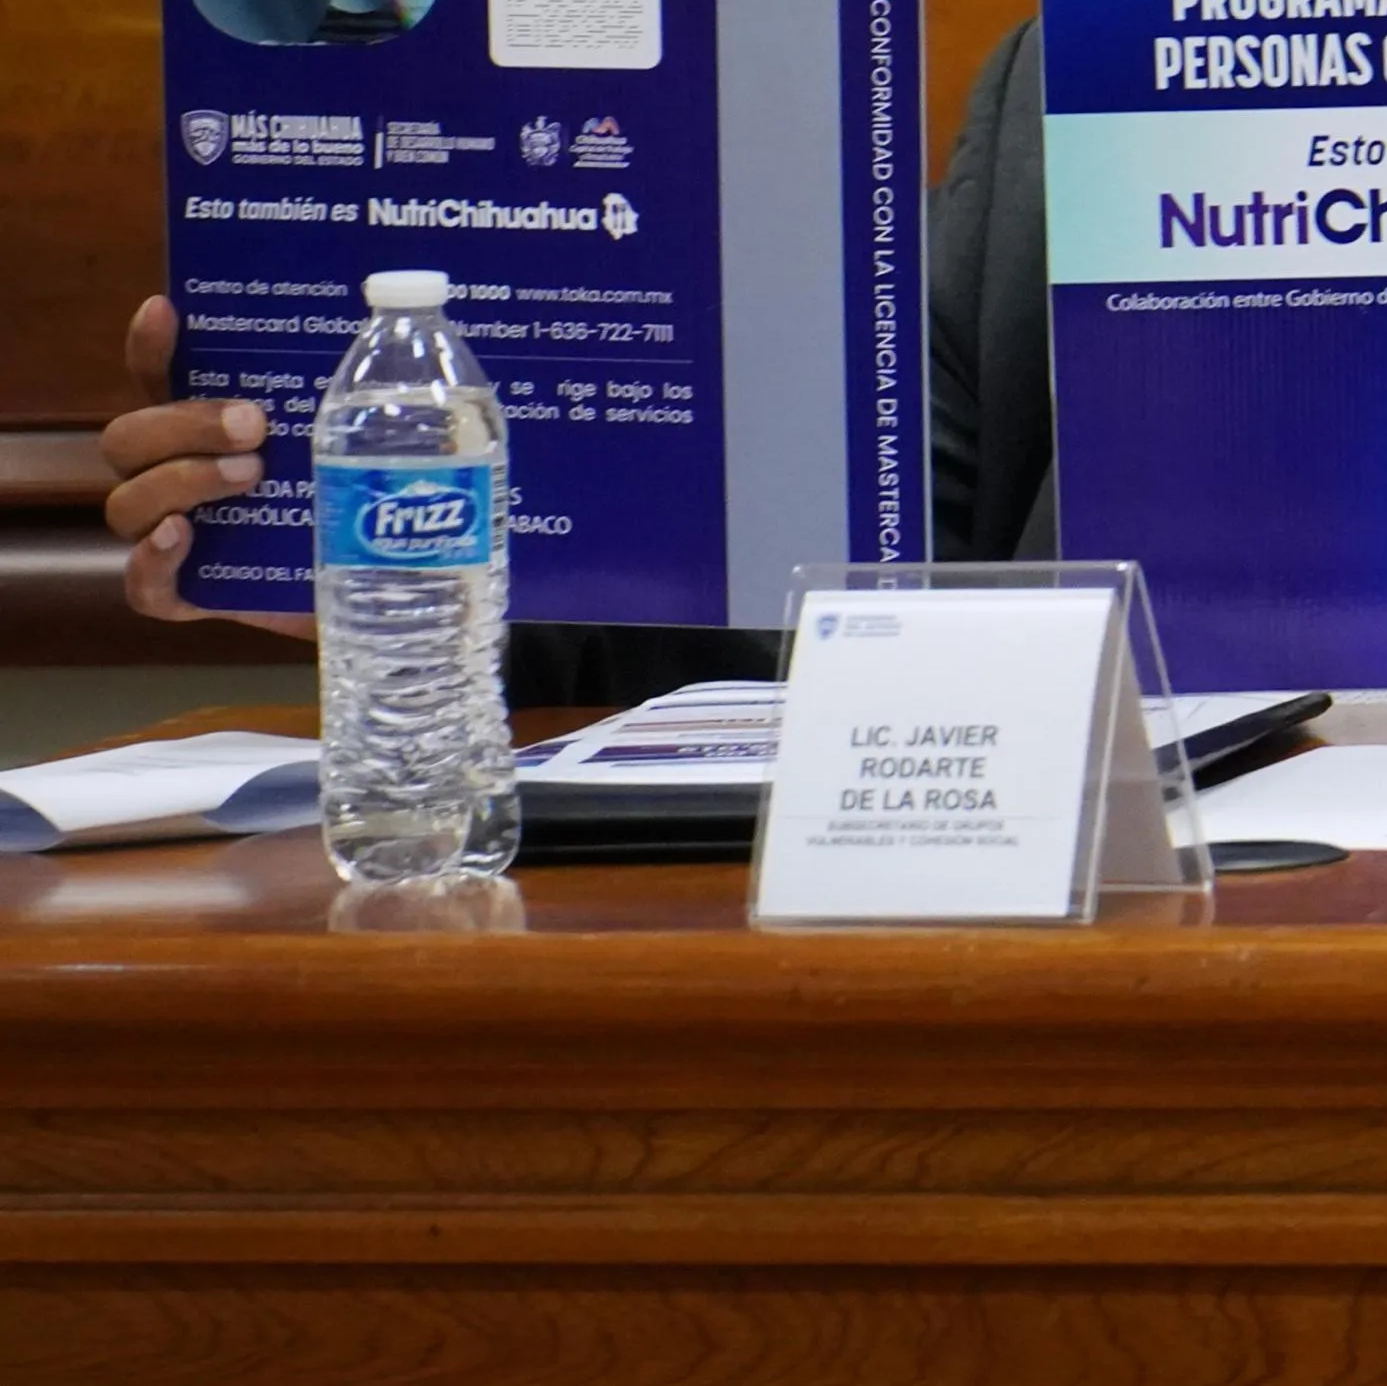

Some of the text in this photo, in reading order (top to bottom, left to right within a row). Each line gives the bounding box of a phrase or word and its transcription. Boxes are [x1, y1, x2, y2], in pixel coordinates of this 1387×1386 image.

[1154, 33, 1373, 90] PERSONAS
[1307, 133, 1386, 167] Esto
[185, 197, 597, 231] Esto también es NutriChihuahua
[872, 186, 895, 243] CON
[873, 250, 895, 277] LA
[185, 279, 242, 295] Centro
[246, 280, 269, 295] de
[272, 281, 349, 296] atención
[1106, 291, 1229, 312] Colaboración
[1233, 292, 1282, 308] entre
[1285, 288, 1374, 307] Gobierno
[187, 314, 300, 333] Mastercard
[874, 283, 897, 392] LICENCIA
[188, 370, 229, 387] Esta
[239, 371, 304, 392] tarjeta
[510, 382, 534, 396] se
[556, 380, 596, 402] rige
[607, 380, 652, 403] bajo
[662, 381, 693, 400] los
[285, 395, 315, 412] del
[569, 404, 596, 421] de
[606, 406, 693, 424] servicios
[876, 398, 898, 428] DE
[375, 499, 466, 536] Frizz
[198, 563, 264, 581] CÓDIGO
[266, 566, 292, 581] DEL
[851, 725, 999, 747] LIC. JAVIER
[860, 757, 985, 778] RODARTE
[840, 789, 996, 811] DE LA ROSA
